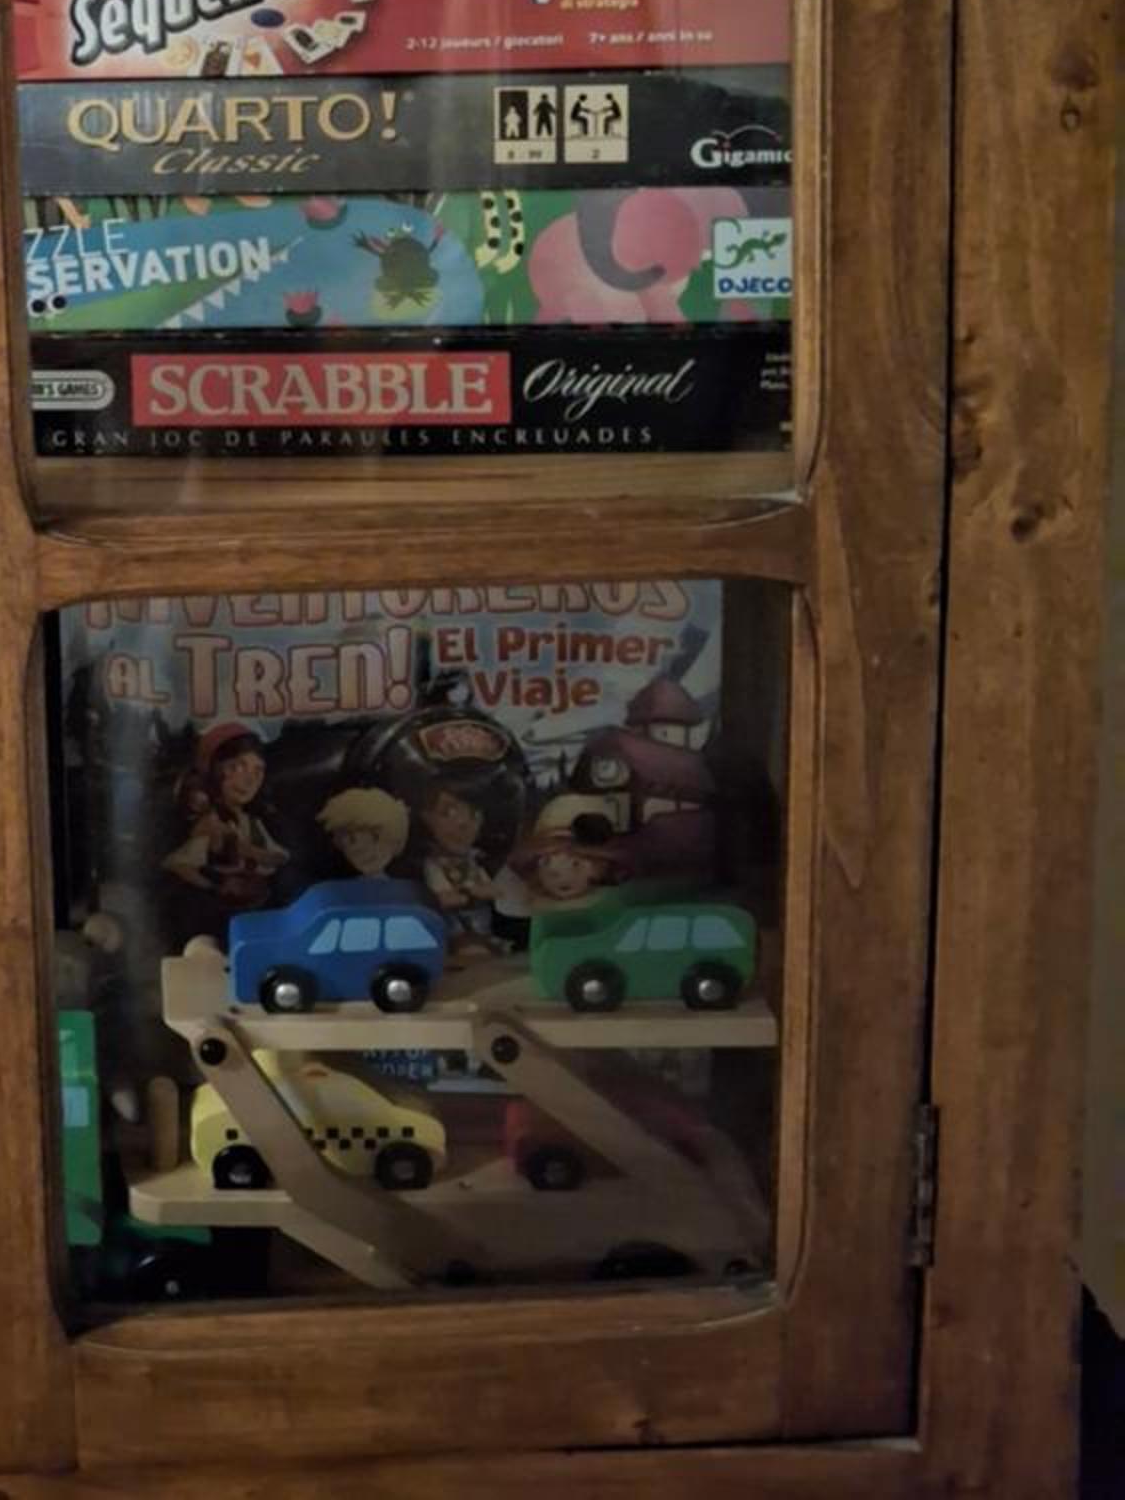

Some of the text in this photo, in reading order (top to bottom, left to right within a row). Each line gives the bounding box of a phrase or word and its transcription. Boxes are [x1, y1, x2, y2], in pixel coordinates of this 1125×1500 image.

[67, 91, 397, 151] QUARTO!
[153, 146, 322, 176] Classic
[690, 137, 793, 169] Gigamic
[26, 237, 272, 300] SERVATION
[718, 277, 793, 294] DJECO
[149, 361, 493, 417] SCRABBLE
[523, 358, 697, 421] Original
[52, 429, 128, 447] GRAN
[227, 429, 258, 447] DE
[281, 428, 431, 447] PARAULES
[452, 426, 653, 445] ENCREUADES
[436, 622, 674, 667] El Primer
[105, 624, 412, 718] AL TREN!
[474, 667, 604, 715] Viaje
